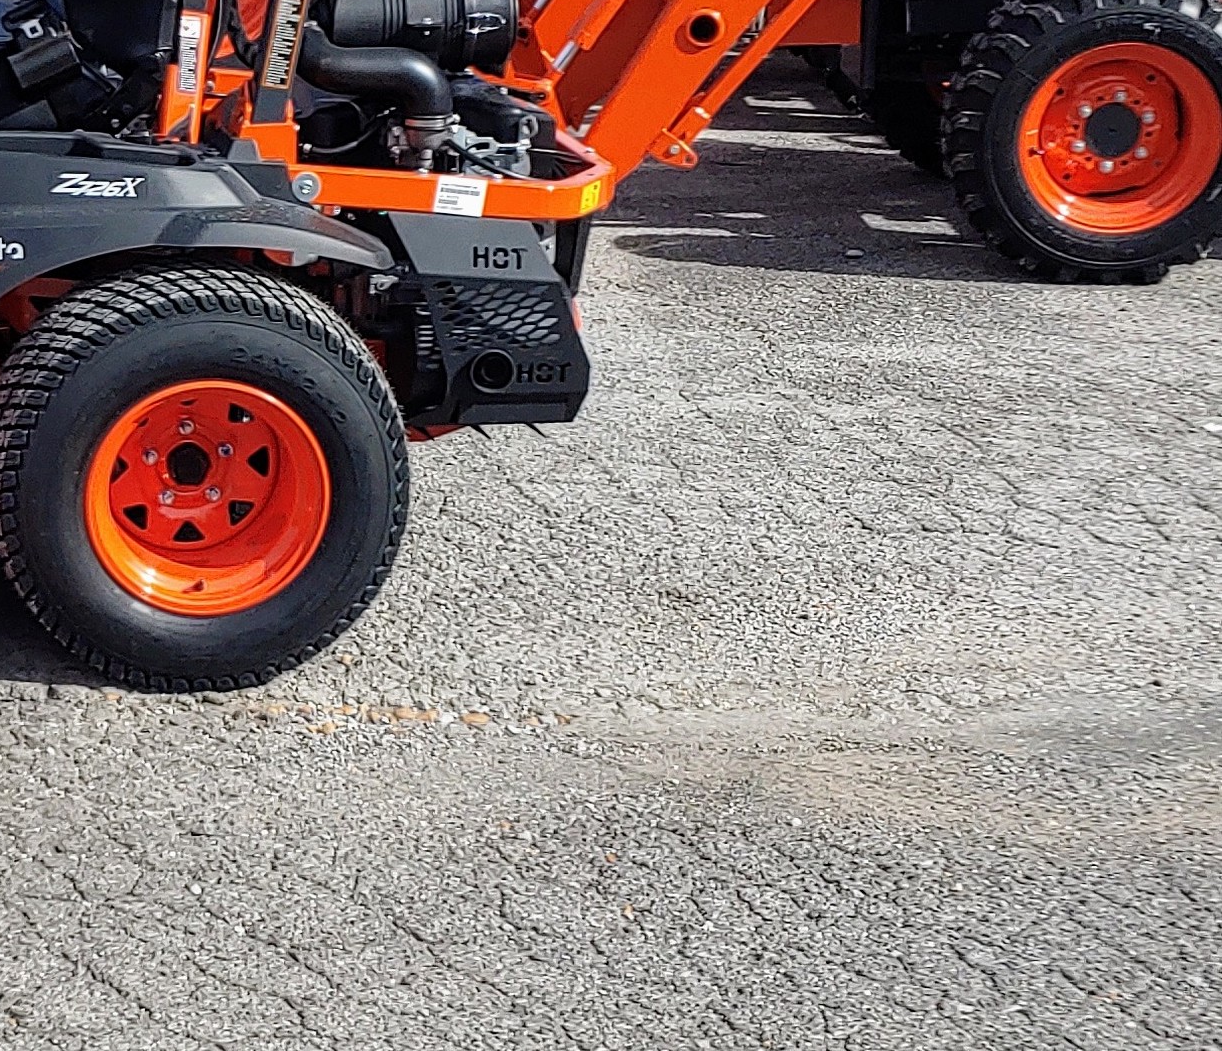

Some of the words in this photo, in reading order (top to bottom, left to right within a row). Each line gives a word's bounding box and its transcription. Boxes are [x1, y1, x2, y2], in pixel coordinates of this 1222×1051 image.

[50, 173, 145, 197] Z726X
[472, 246, 528, 270] HOT
[516, 362, 572, 384] HOT
